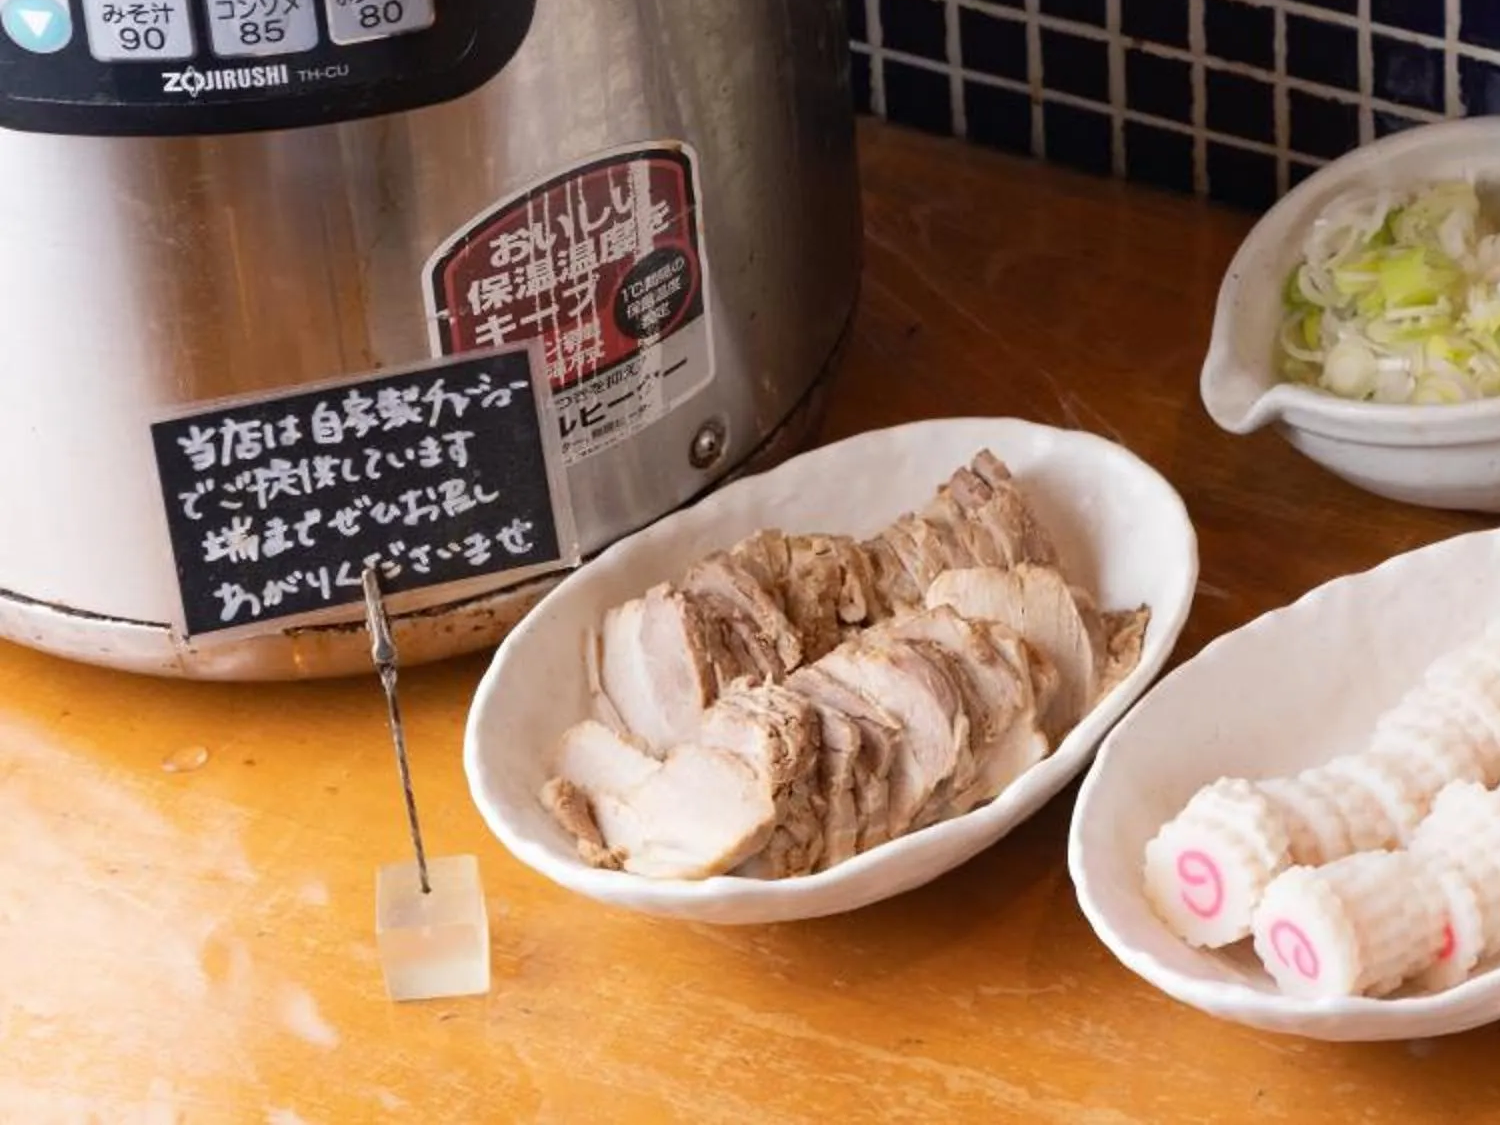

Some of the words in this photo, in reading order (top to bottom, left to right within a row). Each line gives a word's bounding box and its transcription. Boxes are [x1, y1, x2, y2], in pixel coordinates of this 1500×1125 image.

[102, 2, 175, 25] みそ汁
[359, 0, 403, 28] 80
[119, 27, 166, 51] 90
[239, 19, 286, 44] 85
[162, 64, 289, 98] ZOJIRUSHI
[296, 64, 350, 83] TH-CU
[474, 271, 601, 347] キープ
